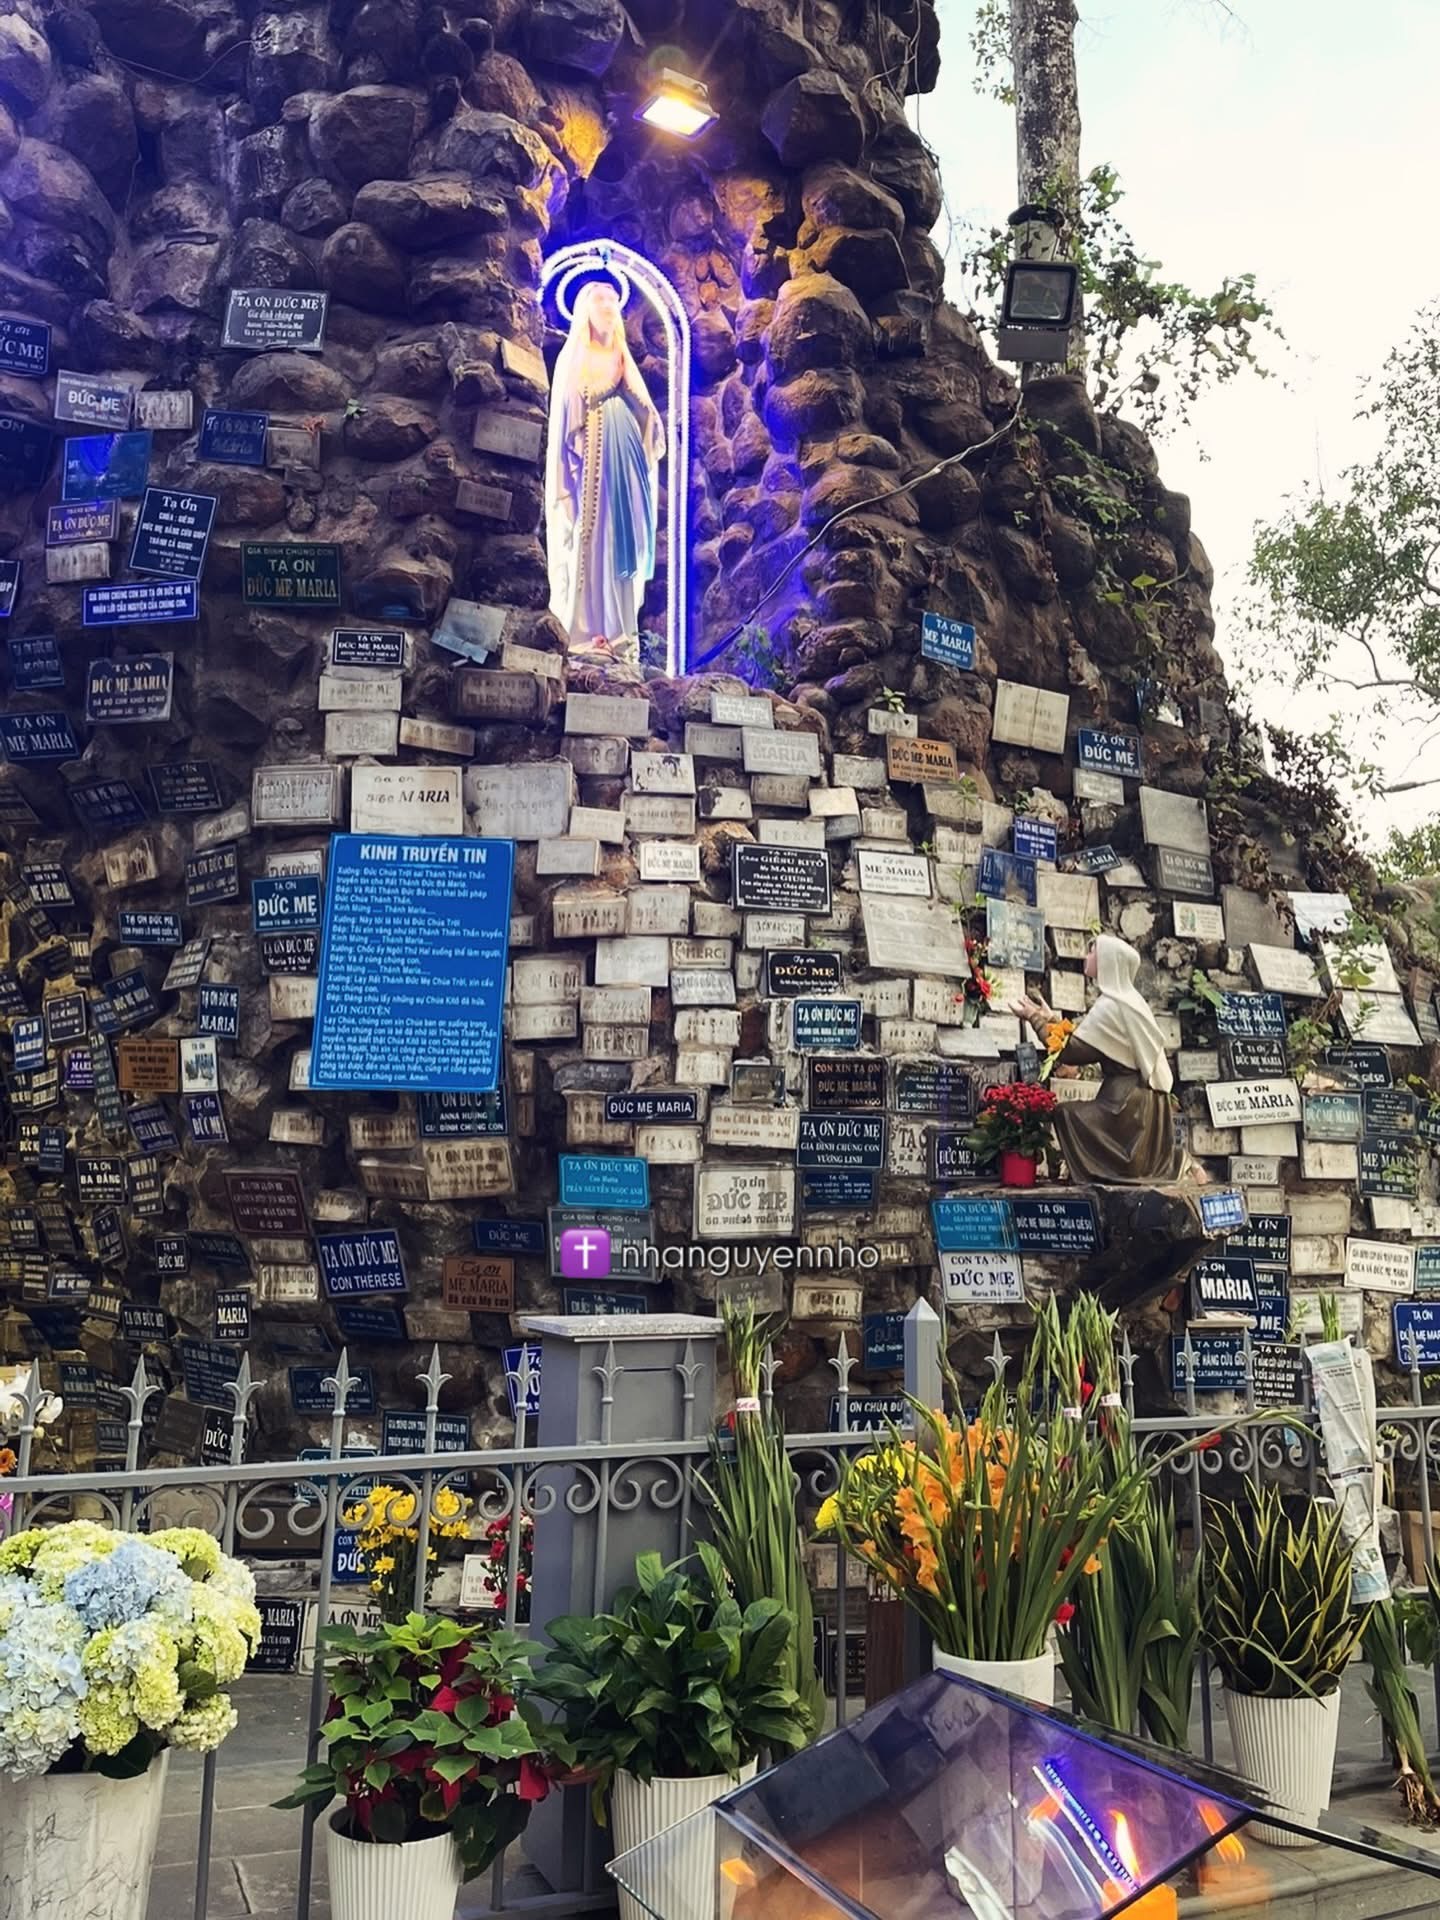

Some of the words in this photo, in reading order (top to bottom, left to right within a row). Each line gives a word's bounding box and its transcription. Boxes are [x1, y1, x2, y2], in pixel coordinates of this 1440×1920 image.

[68, 389, 96, 407] ĐỨC
[101, 396, 120, 414] MẸ
[268, 559, 288, 575] TẠ
[293, 557, 315, 573] ƠN
[297, 578, 337, 598] MARIA
[941, 635, 972, 653] MARIA
[30, 732, 73, 750] MARIA
[1092, 733, 1107, 746] TẠ
[1110, 734, 1125, 746] ƠN
[926, 754, 953, 768] MARIA
[1084, 742, 1112, 762] ĐỨC
[1115, 750, 1134, 767] MẸ
[400, 791, 449, 802] MARIA
[361, 844, 397, 860] KINH
[463, 848, 487, 863] TIN
[770, 865, 806, 874] MARIA
[888, 866, 924, 877] MARIA
[258, 891, 289, 917] ĐỨC
[293, 895, 317, 917] MẸ
[775, 964, 807, 976] ĐỨC
[811, 967, 835, 978] MẸ
[798, 1008, 810, 1024] TẠ
[811, 1006, 823, 1021] ƠN
[824, 1004, 844, 1021] ĐỨC
[844, 1008, 856, 1024] MẸ
[1253, 1009, 1281, 1021] MARIA
[200, 1015, 235, 1032] MARIA
[815, 1064, 832, 1073] CON
[610, 1100, 634, 1113] ĐỨC
[637, 1103, 653, 1114] MẸ
[657, 1102, 692, 1112] MARIA
[1248, 1094, 1294, 1109] MARIA
[801, 1122, 817, 1139] TẠ
[819, 1120, 835, 1136] ƠN
[864, 1124, 880, 1141] MẸ
[864, 1144, 880, 1152] CON
[844, 1155, 863, 1163] LINH
[1362, 1153, 1378, 1171] MẸ
[731, 1176, 746, 1189] Tạ
[749, 1176, 765, 1188] ơn
[707, 1187, 751, 1210] ĐỨC
[757, 1191, 787, 1212] MẸ
[1038, 1204, 1050, 1214] TẠ
[1052, 1204, 1066, 1214] ƠN
[1258, 1218, 1278, 1230] ƠN
[322, 1244, 340, 1273] TẠ
[340, 1241, 354, 1266] ƠN
[355, 1235, 380, 1266] ĐỨC
[381, 1240, 399, 1269] MẸ
[951, 1256, 972, 1265] CON
[331, 1276, 352, 1290] CON
[950, 1268, 984, 1286] ĐỨC
[990, 1271, 1015, 1288] MẸ
[471, 1279, 508, 1294] MARIA
[1200, 1278, 1253, 1300] MARIA
[217, 1307, 247, 1324] MARIA
[1260, 1315, 1282, 1334] MẸ
[339, 1535, 353, 1545] CON
[266, 1608, 294, 1626] MARIA
[341, 1609, 359, 1624] ƠN
